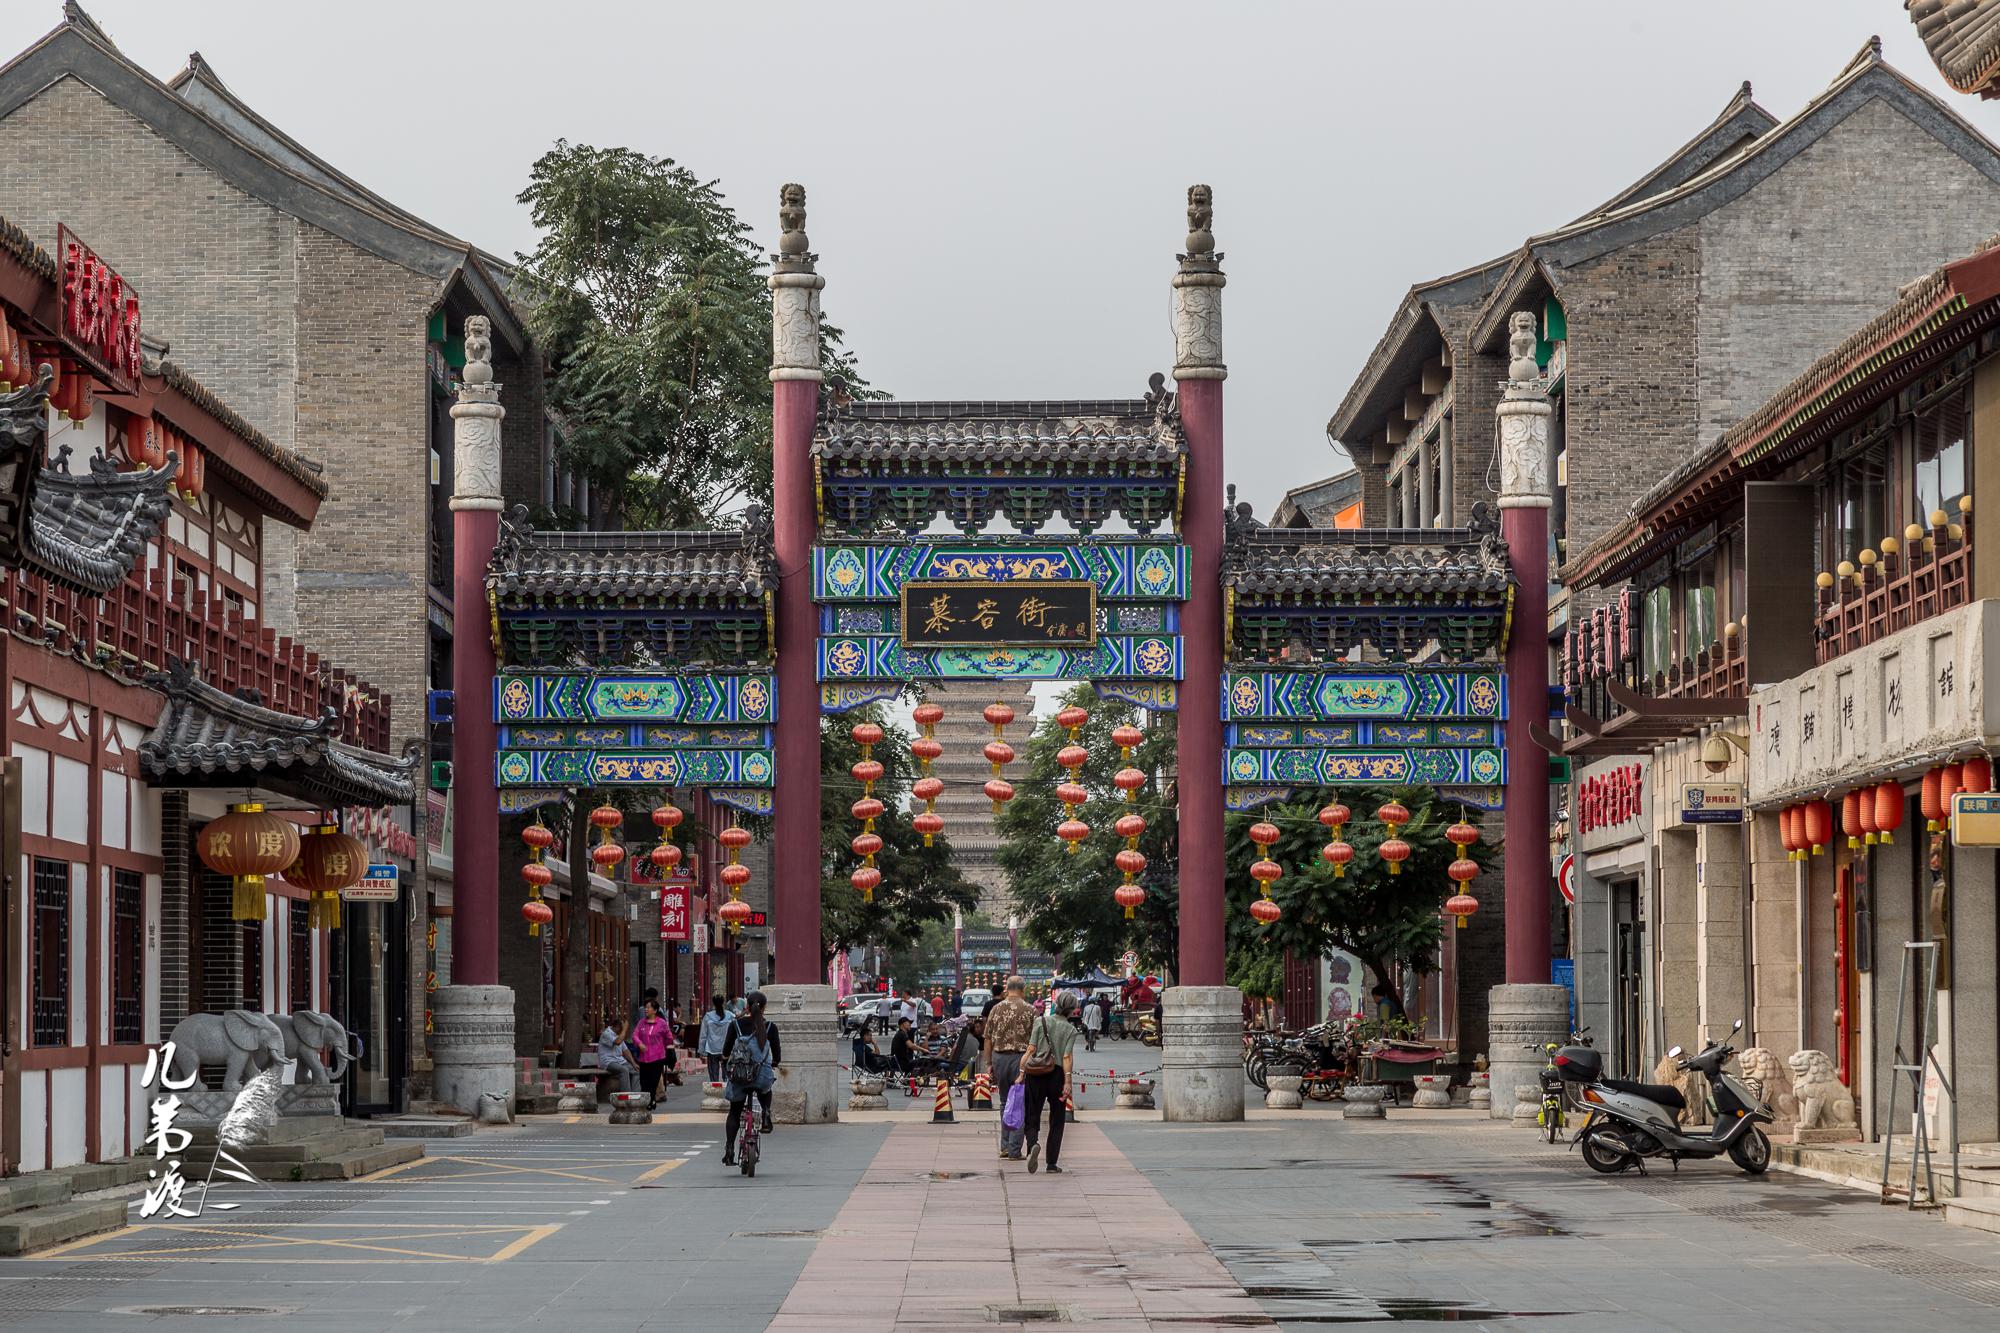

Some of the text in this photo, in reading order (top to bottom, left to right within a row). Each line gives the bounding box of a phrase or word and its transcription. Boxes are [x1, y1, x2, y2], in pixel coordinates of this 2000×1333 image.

[923, 593, 1051, 634] 慕容街
[1705, 795, 1738, 804] 联网报警点
[1963, 800, 1988, 811] 联网
[209, 830, 284, 858] 欢度
